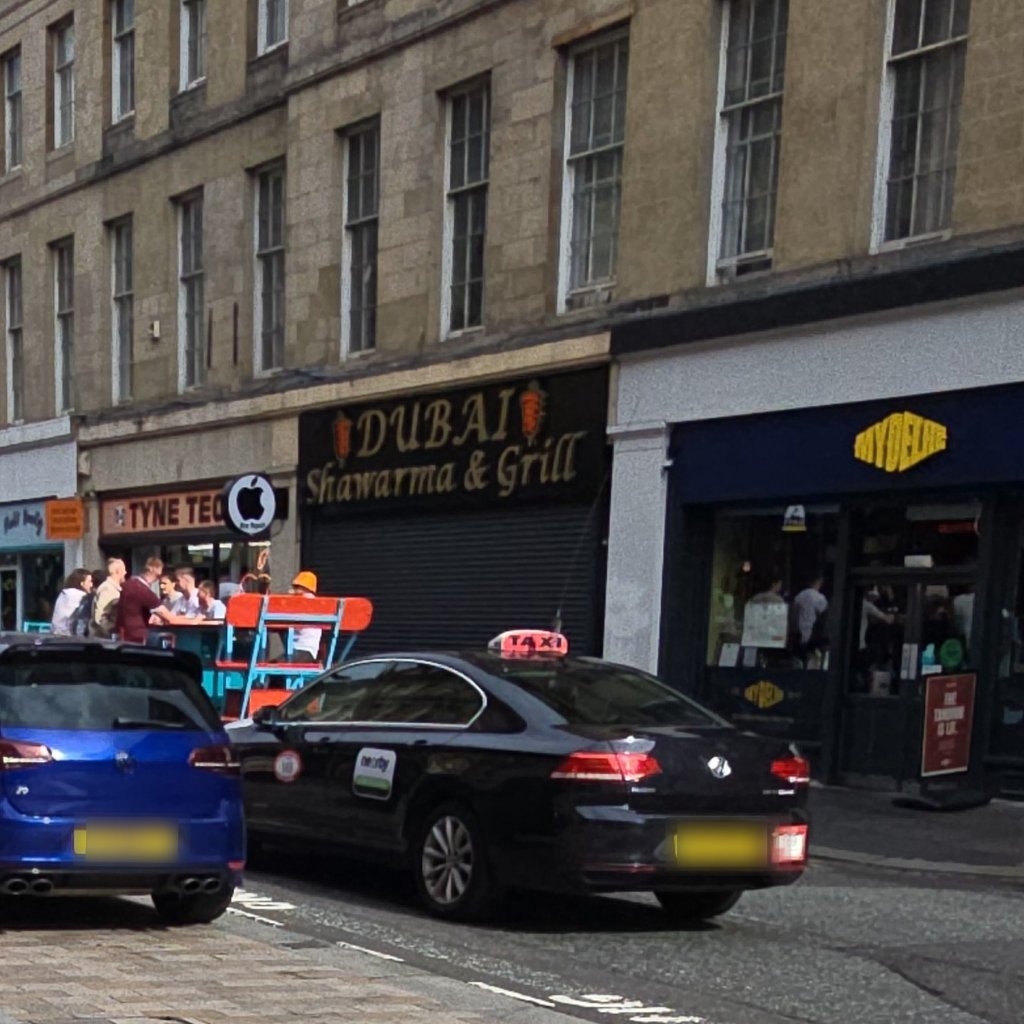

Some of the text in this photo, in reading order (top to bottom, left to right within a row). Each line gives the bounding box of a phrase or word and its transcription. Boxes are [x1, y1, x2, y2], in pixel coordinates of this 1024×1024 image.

[355, 387, 516, 458] DUBAI
[306, 430, 588, 505] Shawarma & Grill
[129, 494, 224, 529] TYNE TEC
[509, 635, 562, 648] TAXI
